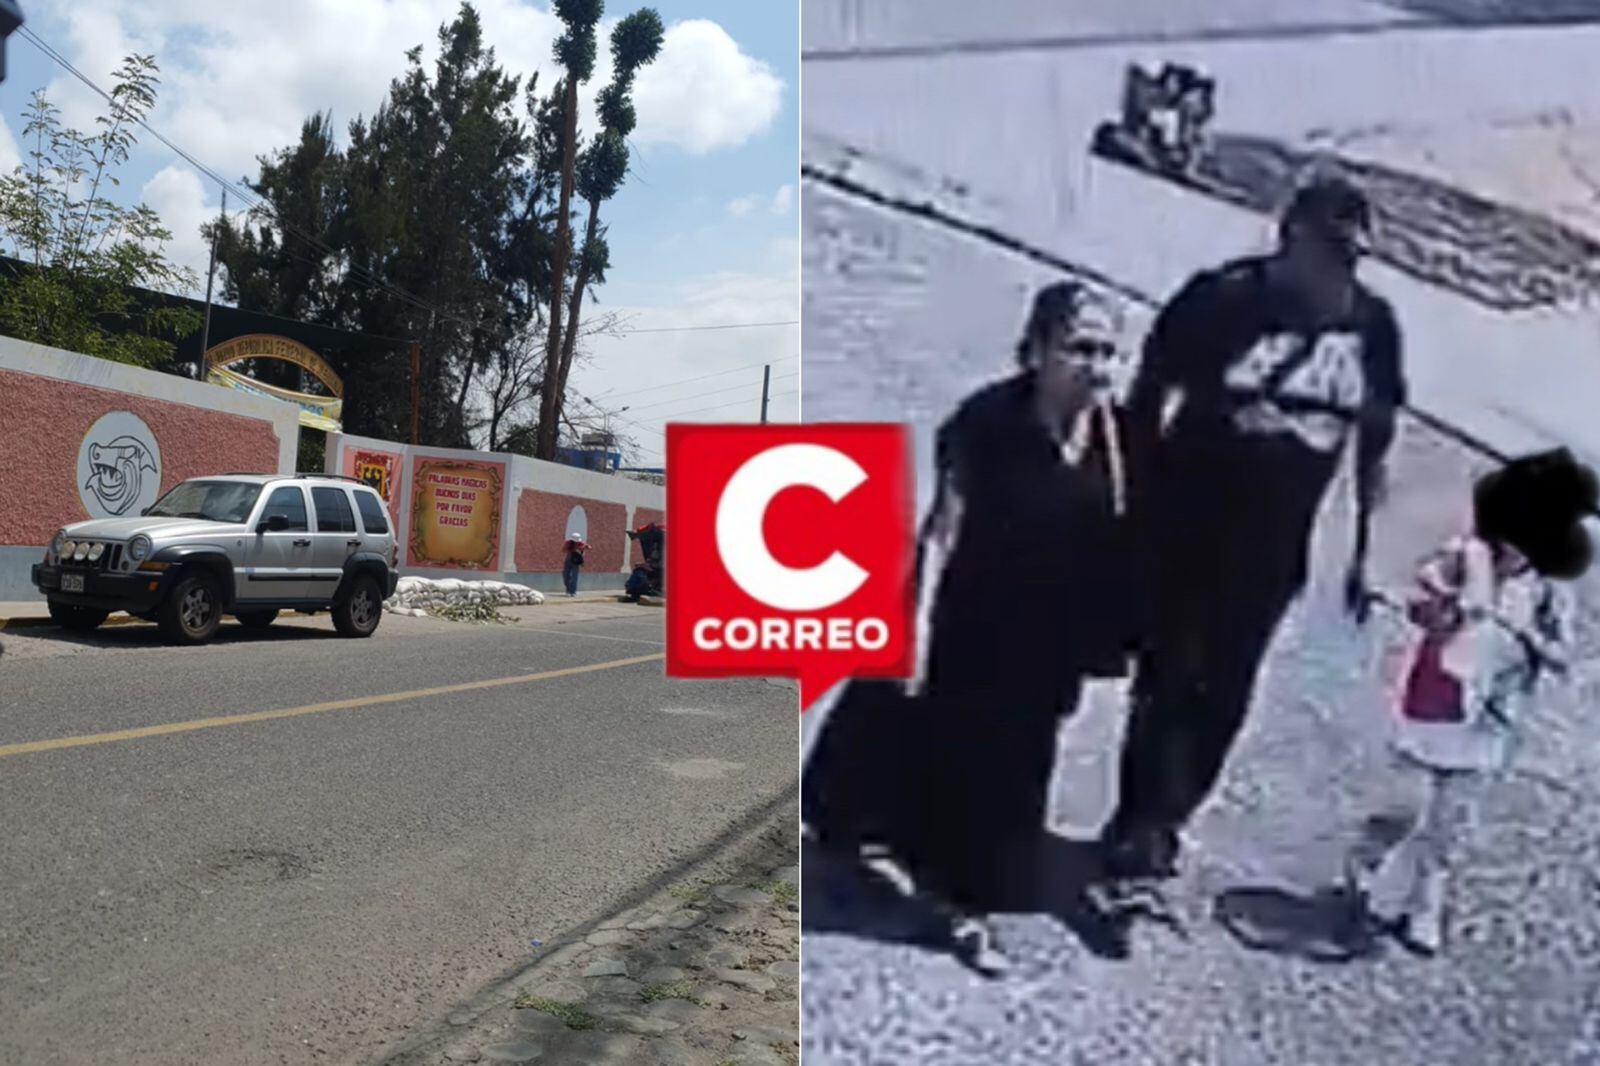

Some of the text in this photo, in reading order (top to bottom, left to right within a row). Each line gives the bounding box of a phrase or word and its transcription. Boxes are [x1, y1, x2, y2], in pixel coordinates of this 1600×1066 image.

[428, 472, 460, 486] PALABRAS
[436, 501, 473, 514] POR FAVOR
[439, 515, 469, 527] GRACIAS
